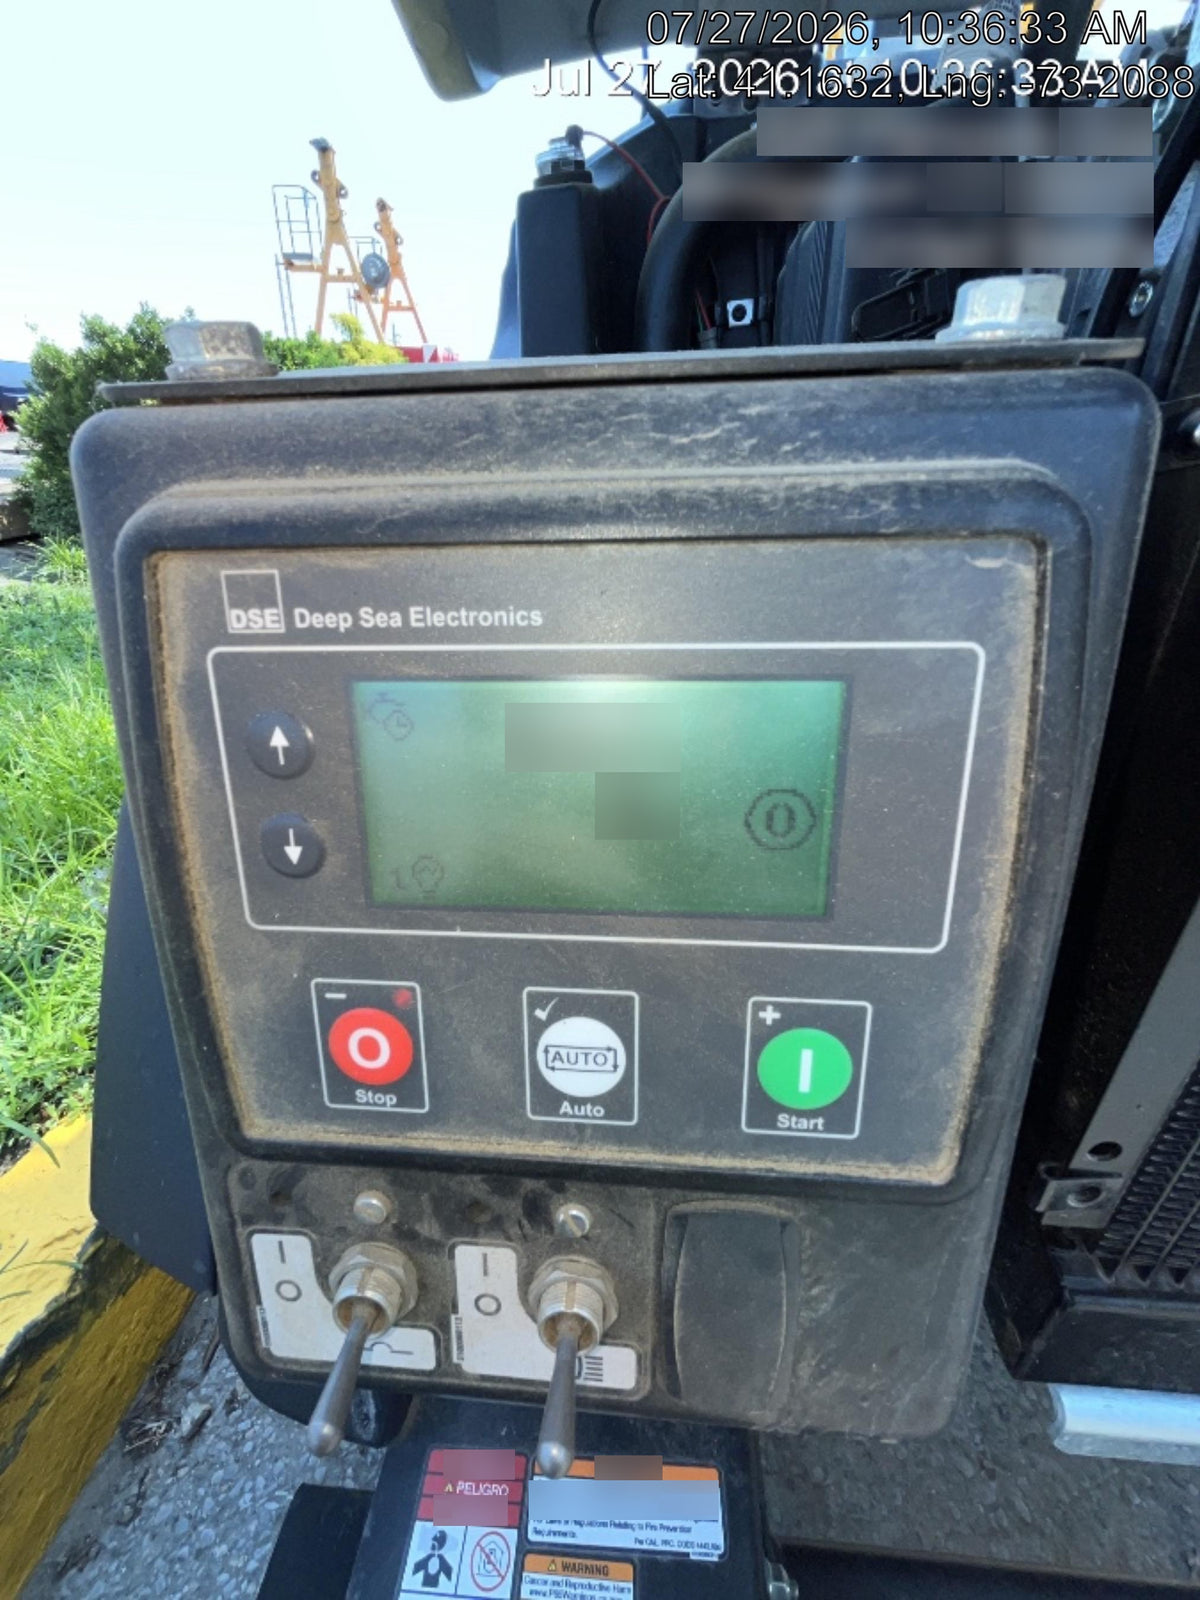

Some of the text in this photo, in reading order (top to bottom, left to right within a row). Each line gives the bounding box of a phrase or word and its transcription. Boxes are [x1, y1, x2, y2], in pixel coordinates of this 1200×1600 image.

[229, 608, 281, 629] DSE
[293, 605, 543, 633] Deep Sea Electronics
[549, 1049, 609, 1069] AUTO
[354, 1088, 398, 1108] Stop
[558, 1100, 606, 1120] Auto
[776, 1112, 825, 1132] Start
[456, 1480, 509, 1496] PELIGRO
[561, 1560, 610, 1577] WARNING
[524, 1575, 549, 1586] Cancer
[550, 1578, 564, 1587] and
[564, 1578, 611, 1592] Reproductive
